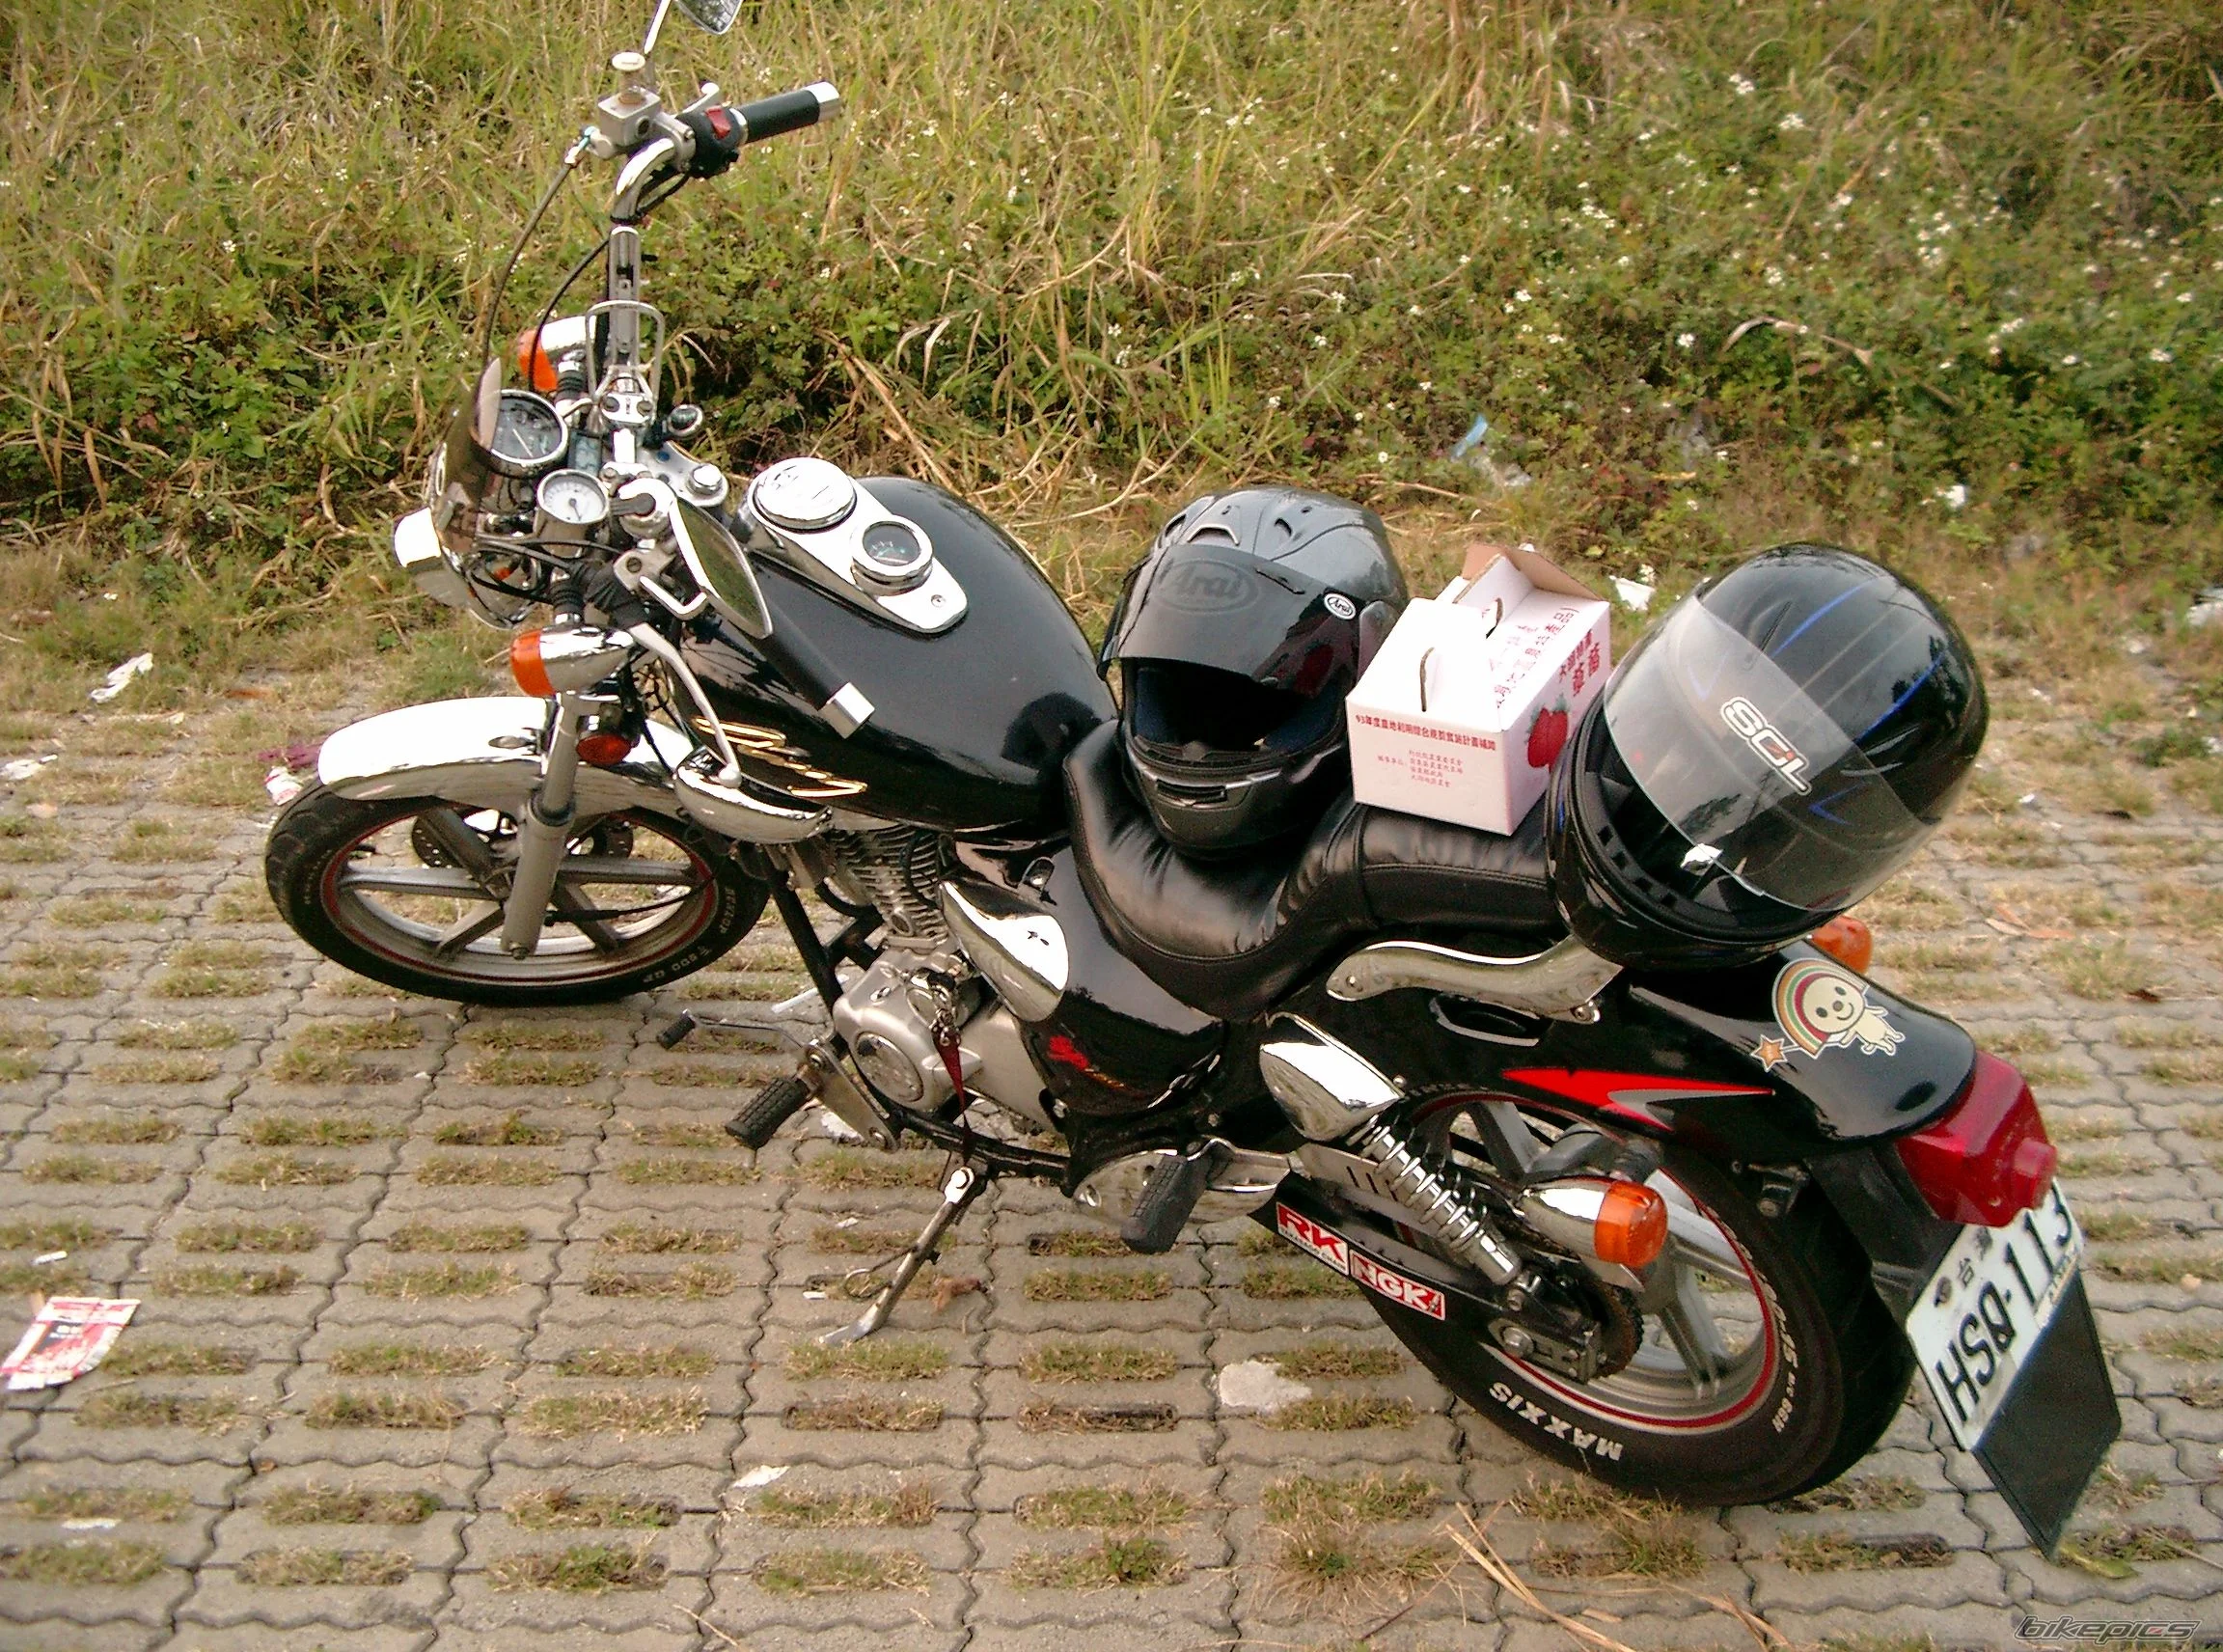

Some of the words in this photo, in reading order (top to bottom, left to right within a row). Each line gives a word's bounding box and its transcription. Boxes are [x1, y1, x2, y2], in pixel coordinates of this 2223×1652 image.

[1277, 1204, 1345, 1264] RK
[1353, 1255, 1428, 1310] NGK
[1489, 1382, 1623, 1461] MAXXIS
